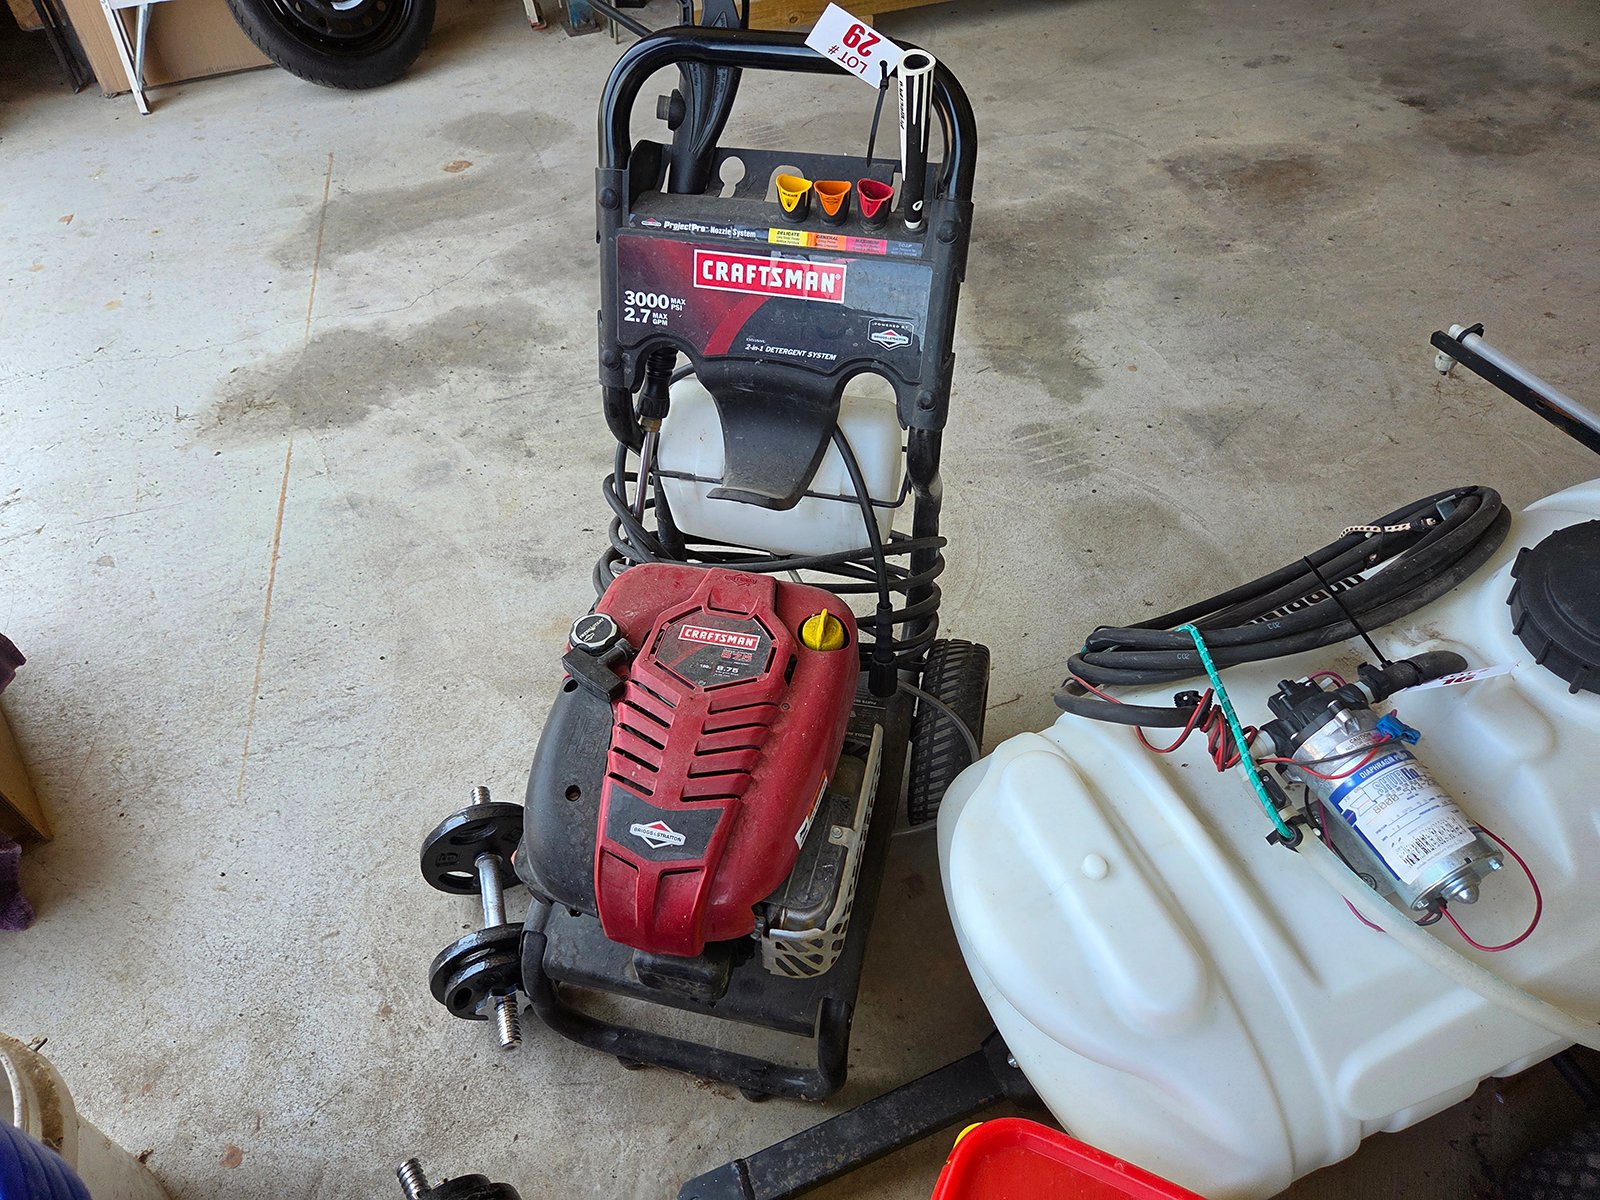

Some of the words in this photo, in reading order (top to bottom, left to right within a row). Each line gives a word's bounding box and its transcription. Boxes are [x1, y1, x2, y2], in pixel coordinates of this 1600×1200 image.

[843, 24, 881, 57] 29
[827, 45, 840, 55] #
[837, 51, 868, 74] LOT
[710, 226, 732, 236] Nozzle
[732, 228, 757, 239] System
[776, 230, 801, 238] DELICATE
[702, 259, 836, 294] CRAFTSMAN
[624, 290, 670, 310] 3000
[670, 297, 686, 306] MAX
[624, 306, 651, 323] 2.7
[652, 312, 668, 320] MAX
[764, 345, 808, 357] DETERGENT
[806, 350, 838, 361] SYSTEM
[684, 628, 755, 647] CRAFTSMAN
